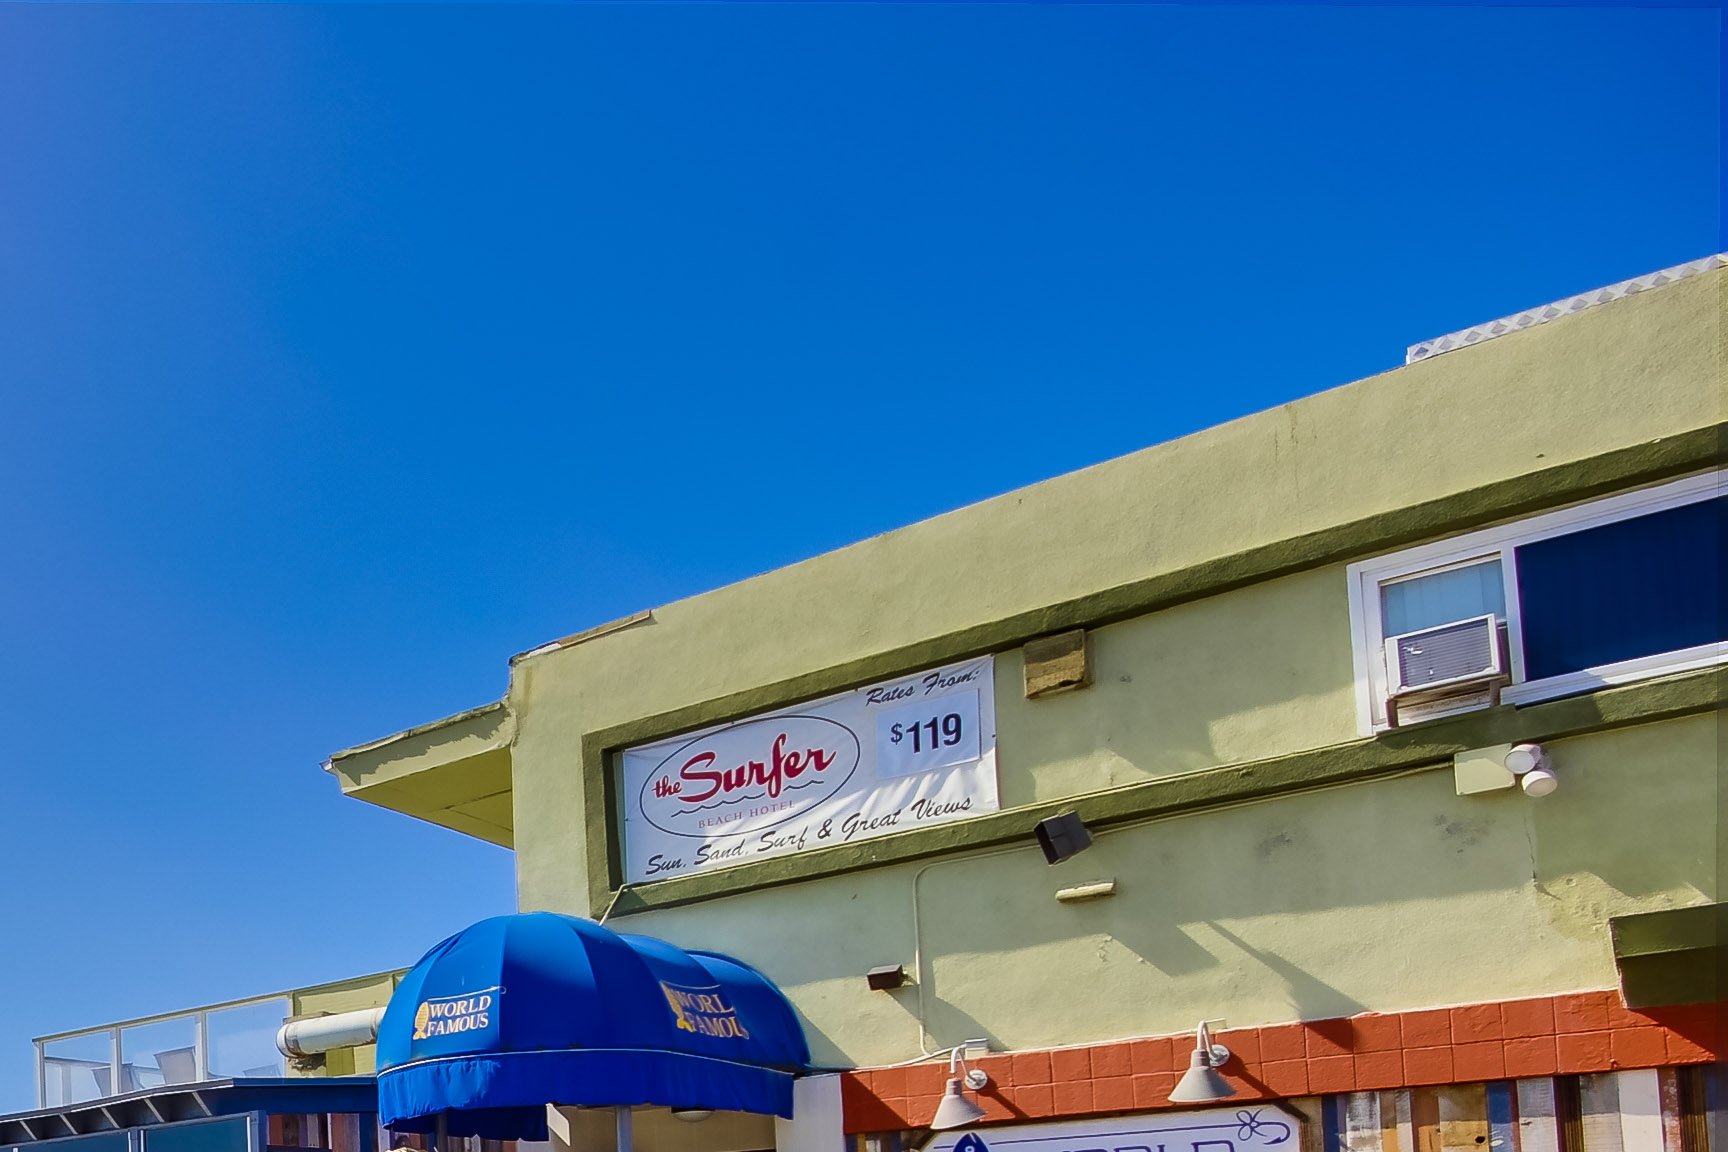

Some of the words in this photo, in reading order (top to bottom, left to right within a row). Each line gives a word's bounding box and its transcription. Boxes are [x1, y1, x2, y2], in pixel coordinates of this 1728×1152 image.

[866, 688, 915, 706] Rates
[922, 670, 980, 696] From:
[890, 713, 962, 754] $119
[651, 775, 682, 799] the
[678, 733, 837, 802] Surfer
[698, 811, 743, 829] BEACH
[750, 801, 795, 817] HOTEL
[757, 826, 809, 851] Surf
[817, 818, 832, 840] &
[841, 808, 902, 842] Great
[911, 797, 973, 820] Views
[429, 995, 492, 1019] WORLD
[673, 990, 736, 1014] WORL
[427, 1012, 489, 1037] FAMOUS
